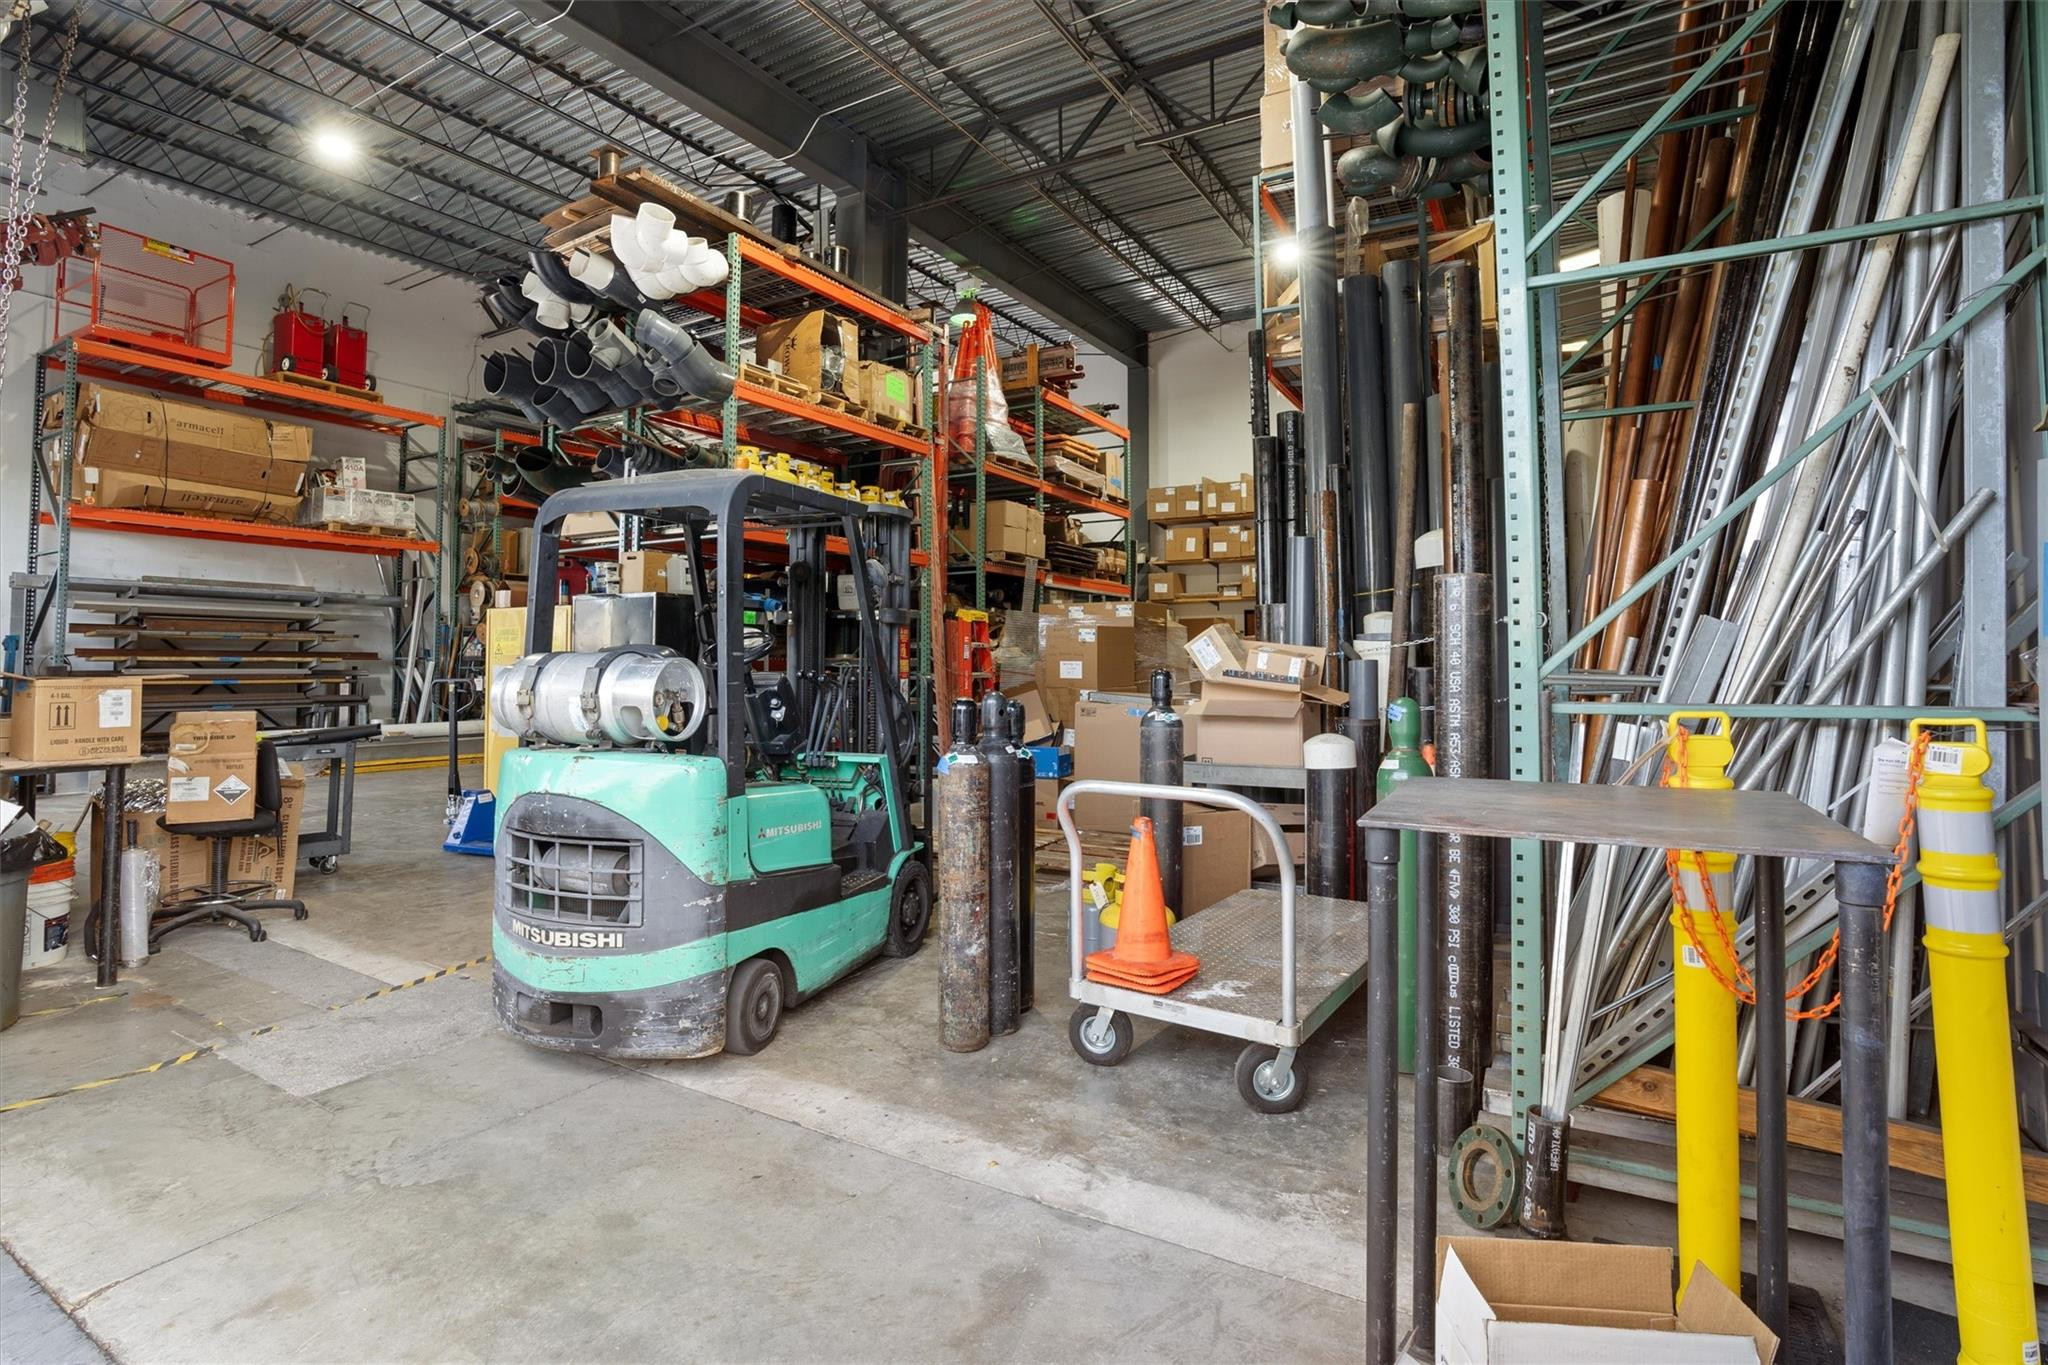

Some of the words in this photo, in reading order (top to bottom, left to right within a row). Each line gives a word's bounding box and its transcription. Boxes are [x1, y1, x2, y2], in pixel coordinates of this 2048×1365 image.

[176, 421, 224, 435] armacell
[1449, 624, 1461, 646] SCH
[1449, 651, 1461, 665] 40
[1449, 672, 1461, 693] USA
[1449, 699, 1461, 727] ASTM
[282, 796, 294, 808] 8"
[766, 820, 822, 838] MITSUBISHI
[1449, 849, 1461, 863] BE
[170, 856, 180, 883] FLEXIBLE
[275, 867, 285, 883] DUCT
[1449, 904, 1461, 924] 300
[512, 919, 624, 949] MITSUBISHI
[1449, 929, 1461, 948] PSI
[1449, 1006, 1461, 1048] LISTED
[1525, 1161, 1534, 1190] PSI
